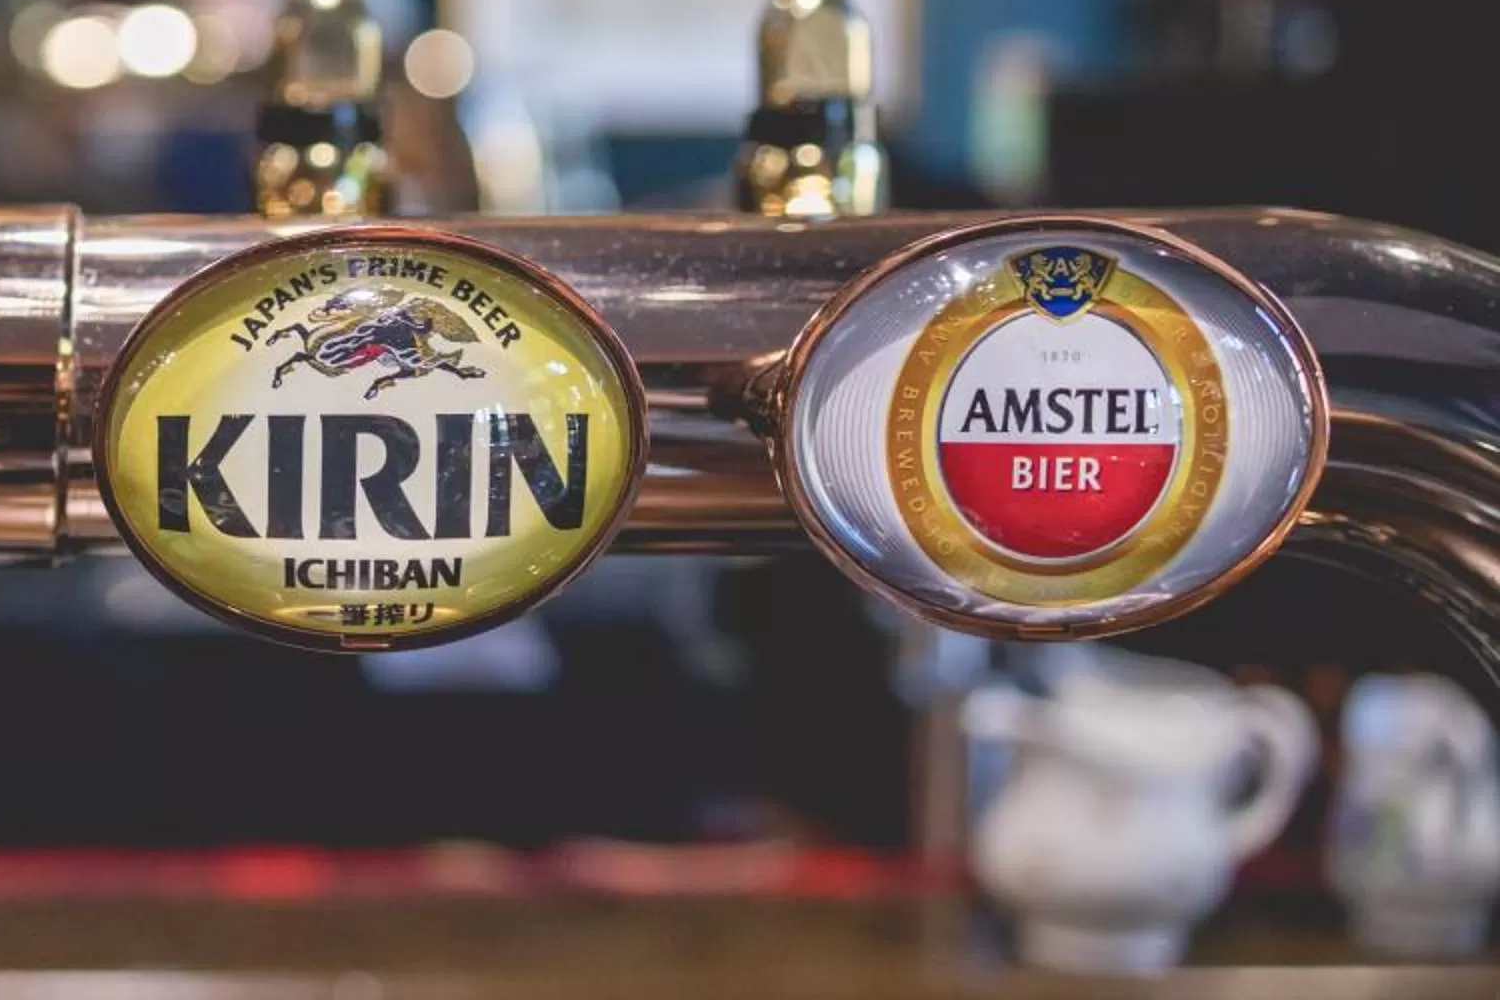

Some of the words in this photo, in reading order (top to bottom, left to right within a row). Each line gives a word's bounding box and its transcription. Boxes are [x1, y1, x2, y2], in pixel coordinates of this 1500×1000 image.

[230, 263, 338, 352] JAPAN'S
[347, 256, 449, 290] PRIME
[451, 278, 521, 350] BEER
[959, 388, 1159, 434] AMSTEL
[896, 385, 925, 513] BREWED
[157, 413, 589, 540] KIRIN
[1011, 456, 1103, 491] BIER
[284, 556, 462, 590] ICHIBAN
[307, 602, 435, 626] 一番搾り
